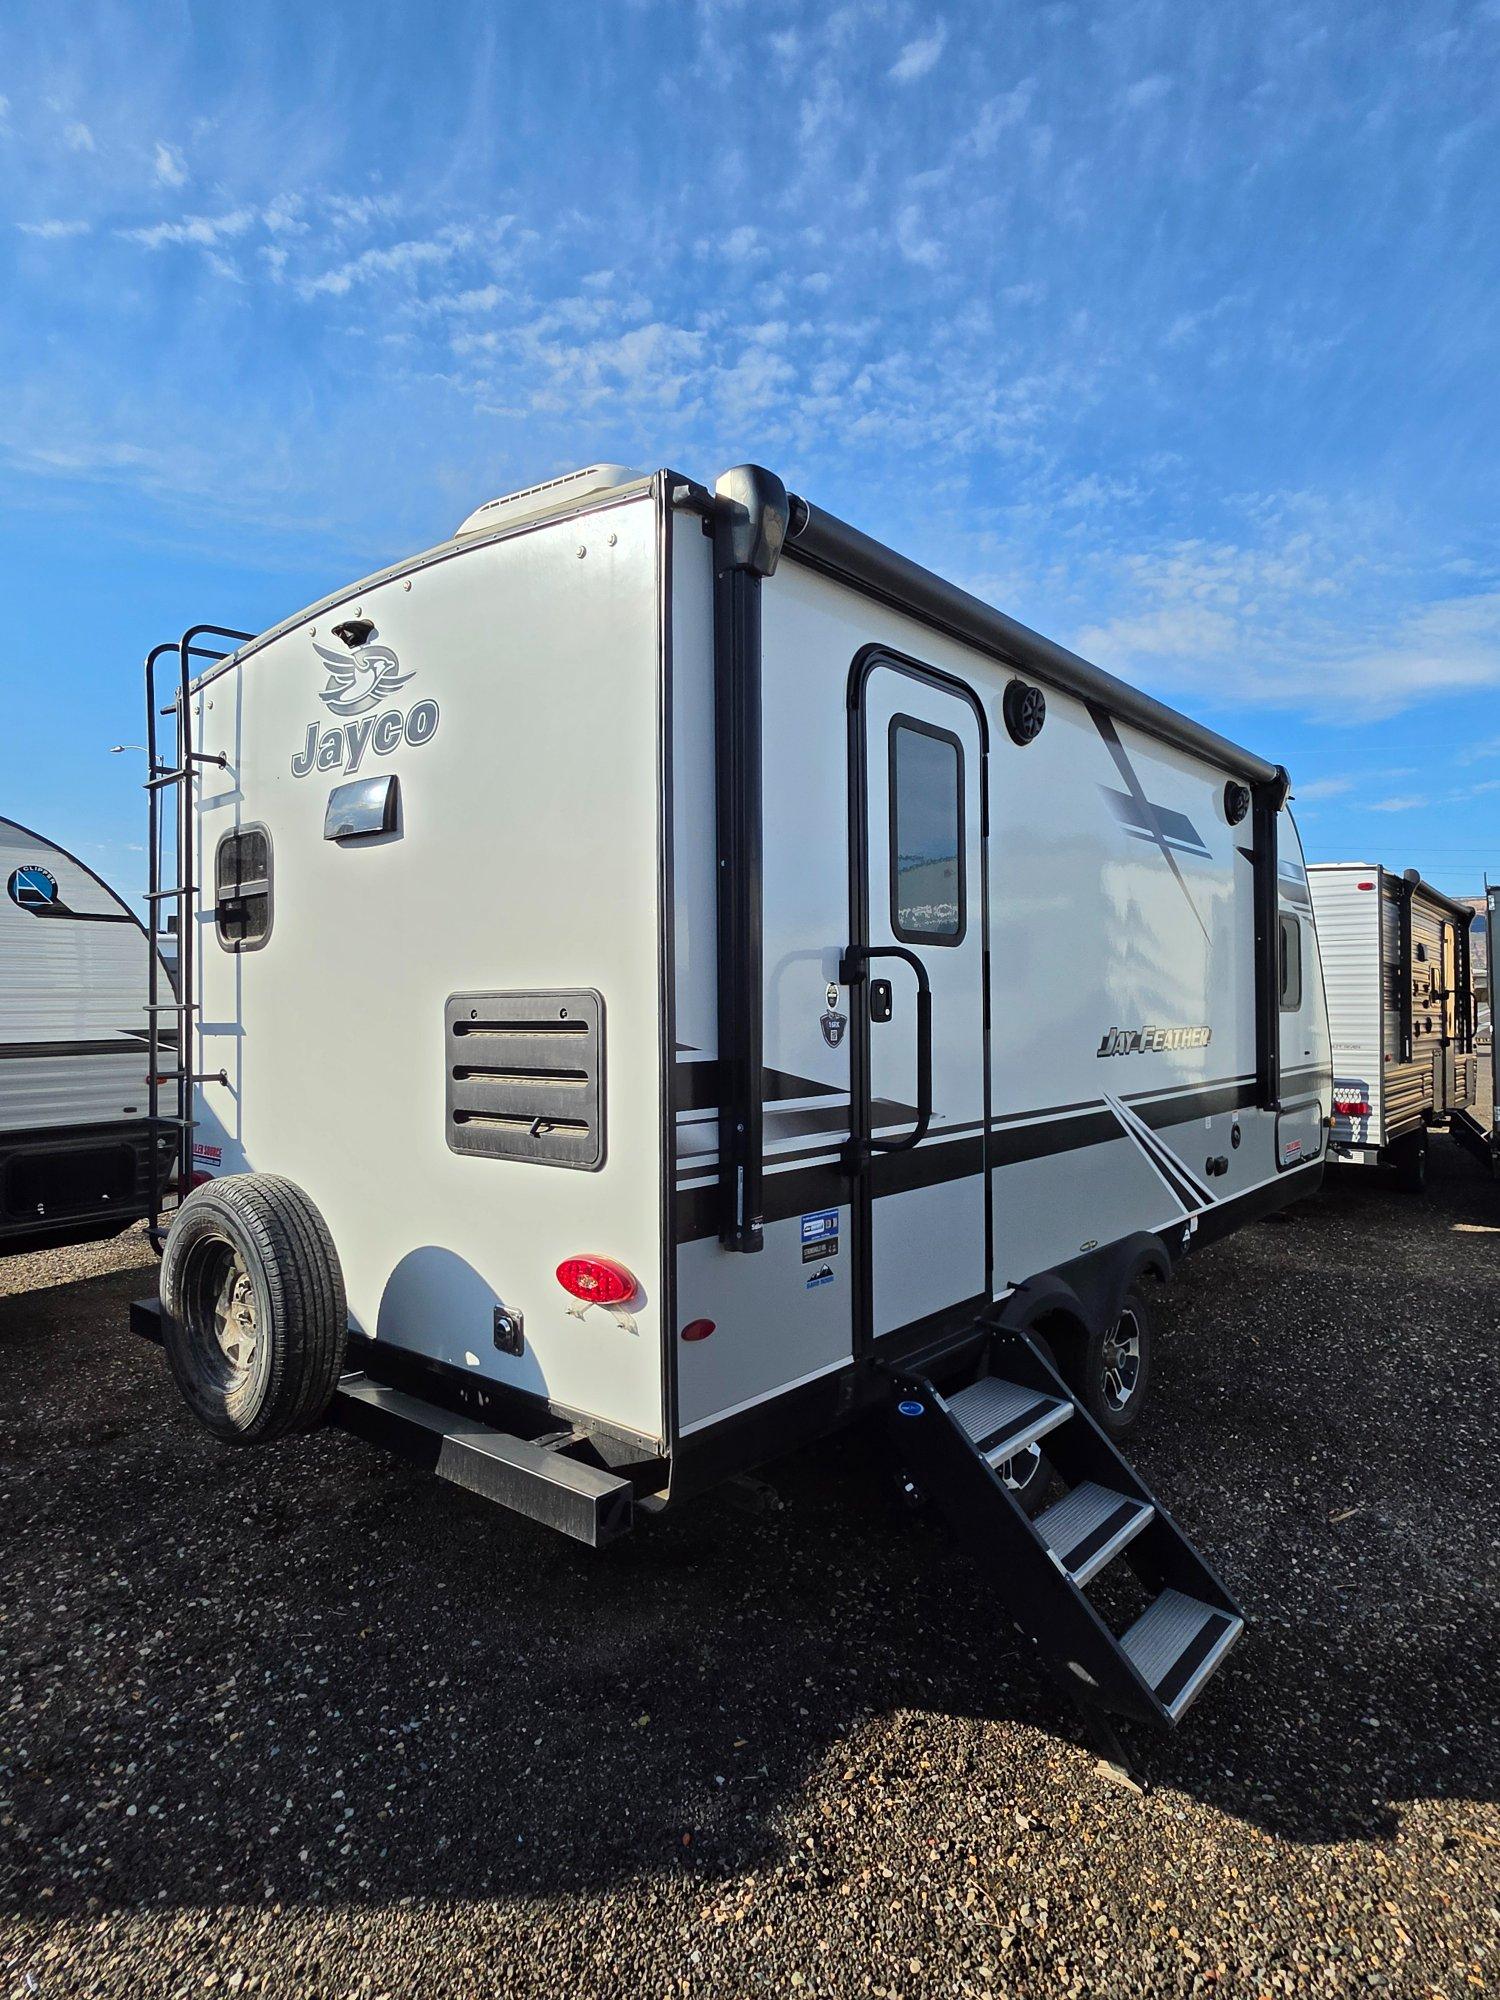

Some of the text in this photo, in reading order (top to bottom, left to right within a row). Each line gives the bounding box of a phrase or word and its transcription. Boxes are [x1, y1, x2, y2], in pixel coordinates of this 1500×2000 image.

[291, 698, 440, 778] Jayco
[22, 866, 56, 885] CLIPPER
[1097, 1025, 1212, 1058] JAY FEATHER
